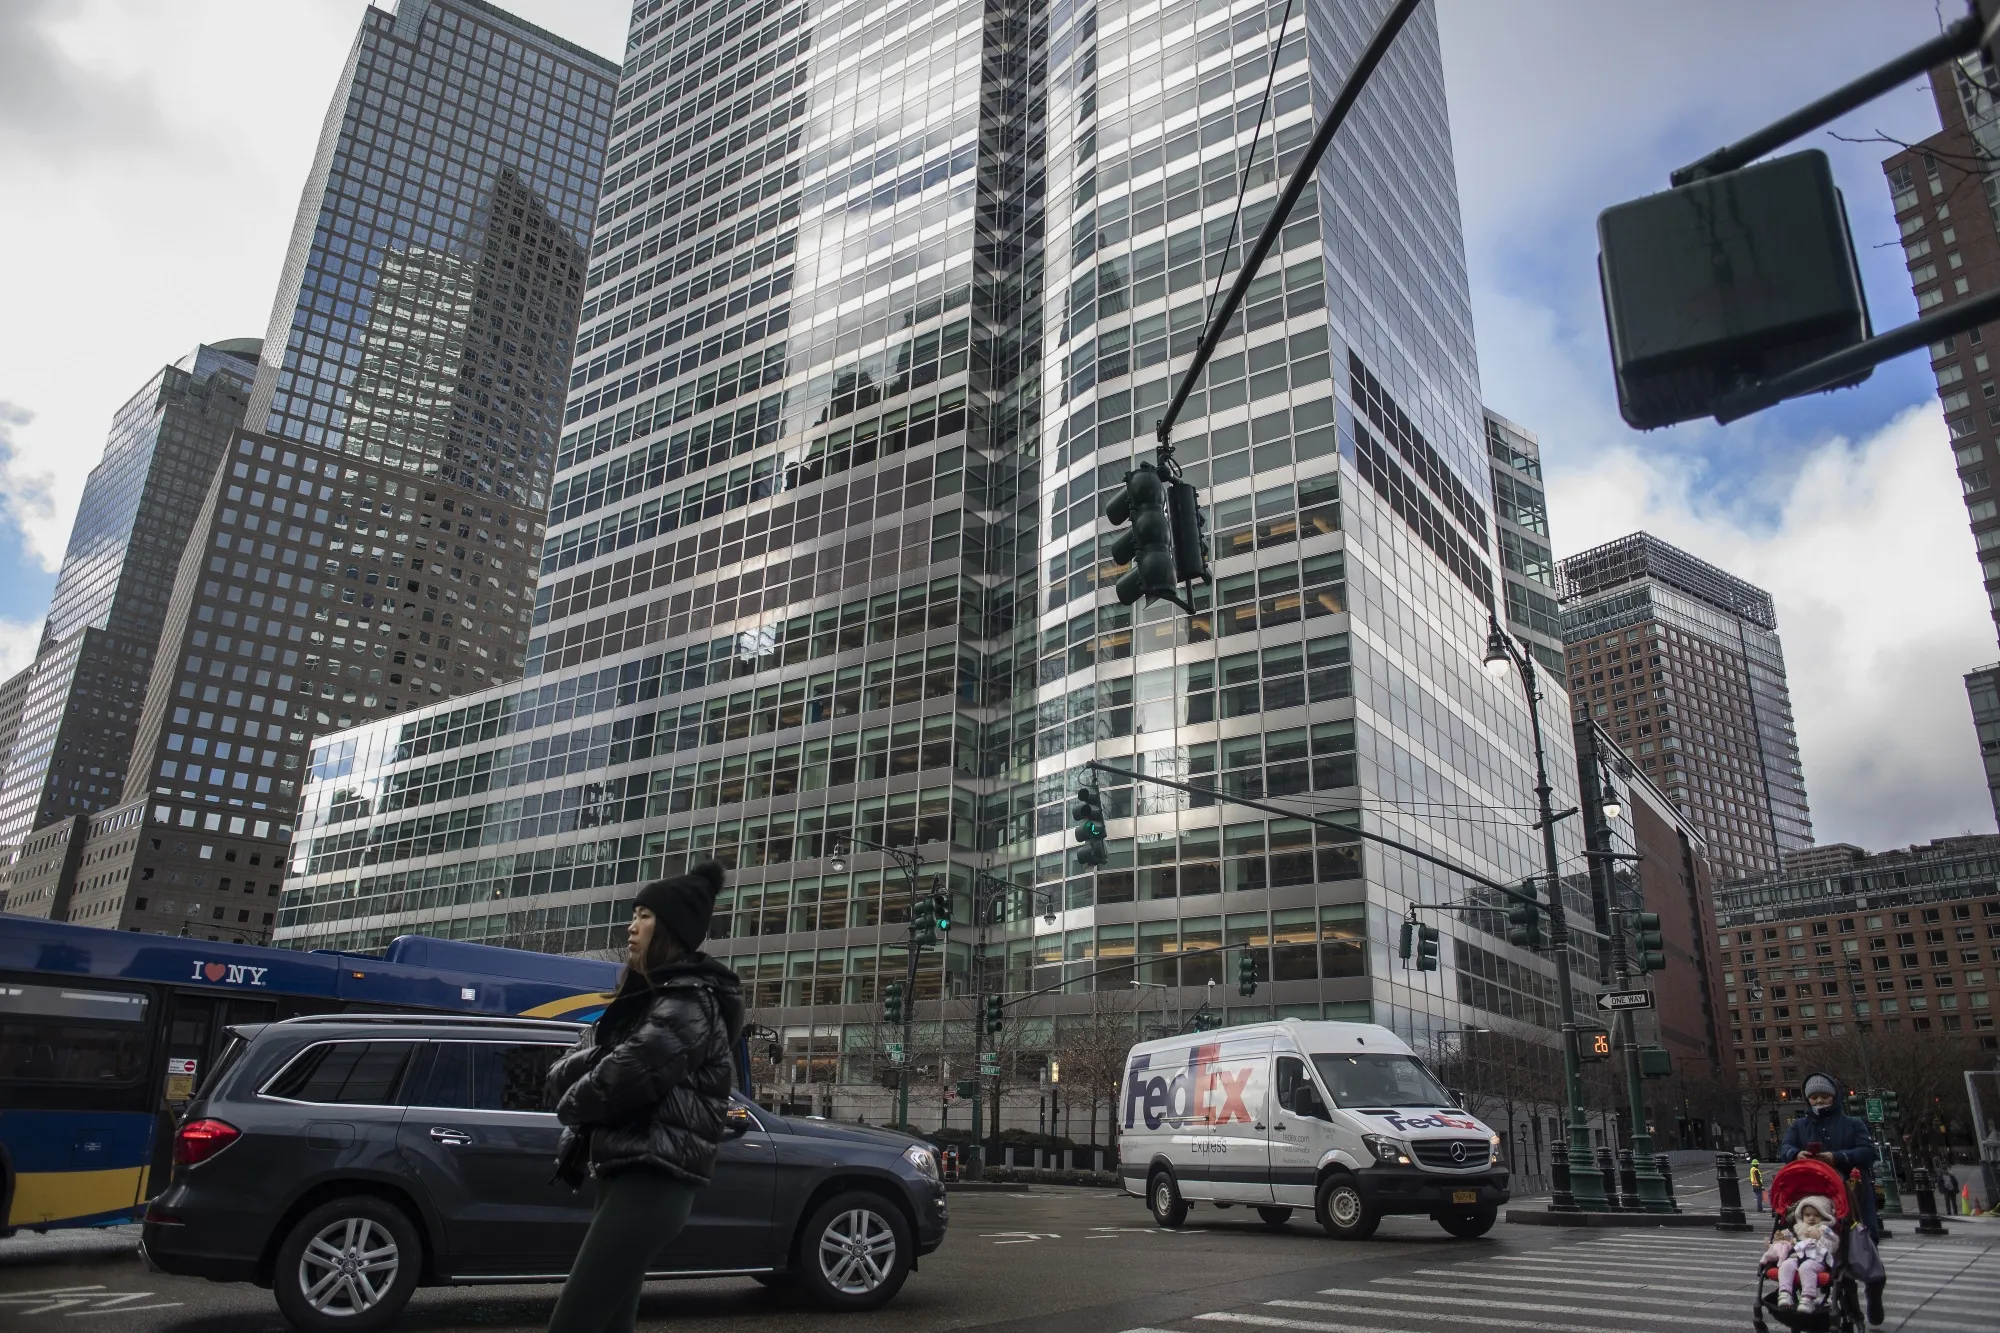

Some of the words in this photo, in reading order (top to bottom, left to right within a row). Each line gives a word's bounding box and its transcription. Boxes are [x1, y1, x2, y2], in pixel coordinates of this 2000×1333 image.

[191, 960, 204, 980] I
[226, 964, 268, 985] NY
[1627, 995, 1643, 1003] WAY
[1594, 1035, 1608, 1053] 26
[1125, 1042, 1254, 1130] FedEx
[1383, 1114, 1485, 1132] FedEx
[1191, 1137, 1227, 1156] Express
[1282, 1132, 1310, 1143] fedex.com
